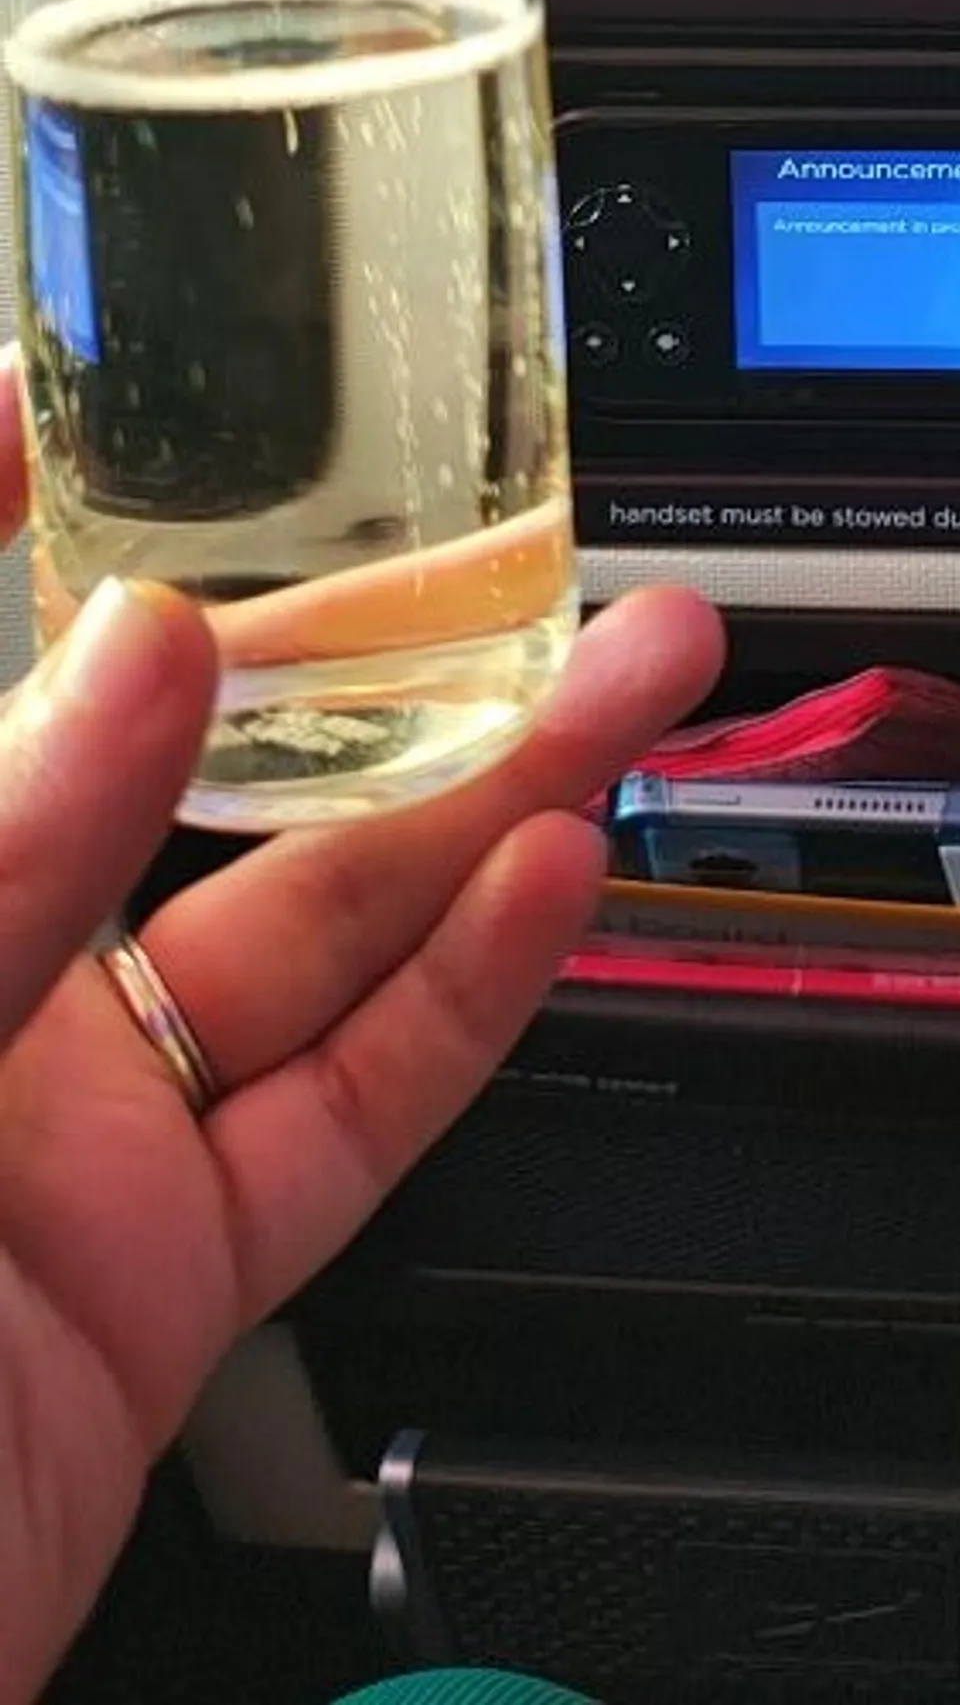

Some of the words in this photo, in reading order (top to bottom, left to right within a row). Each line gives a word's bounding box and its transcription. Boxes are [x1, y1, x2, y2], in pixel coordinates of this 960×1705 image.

[774, 218, 908, 234] Announcement
[911, 218, 928, 234] in
[609, 499, 714, 526] handset
[720, 504, 784, 525] must
[791, 504, 825, 527] be
[832, 505, 927, 529] stowed
